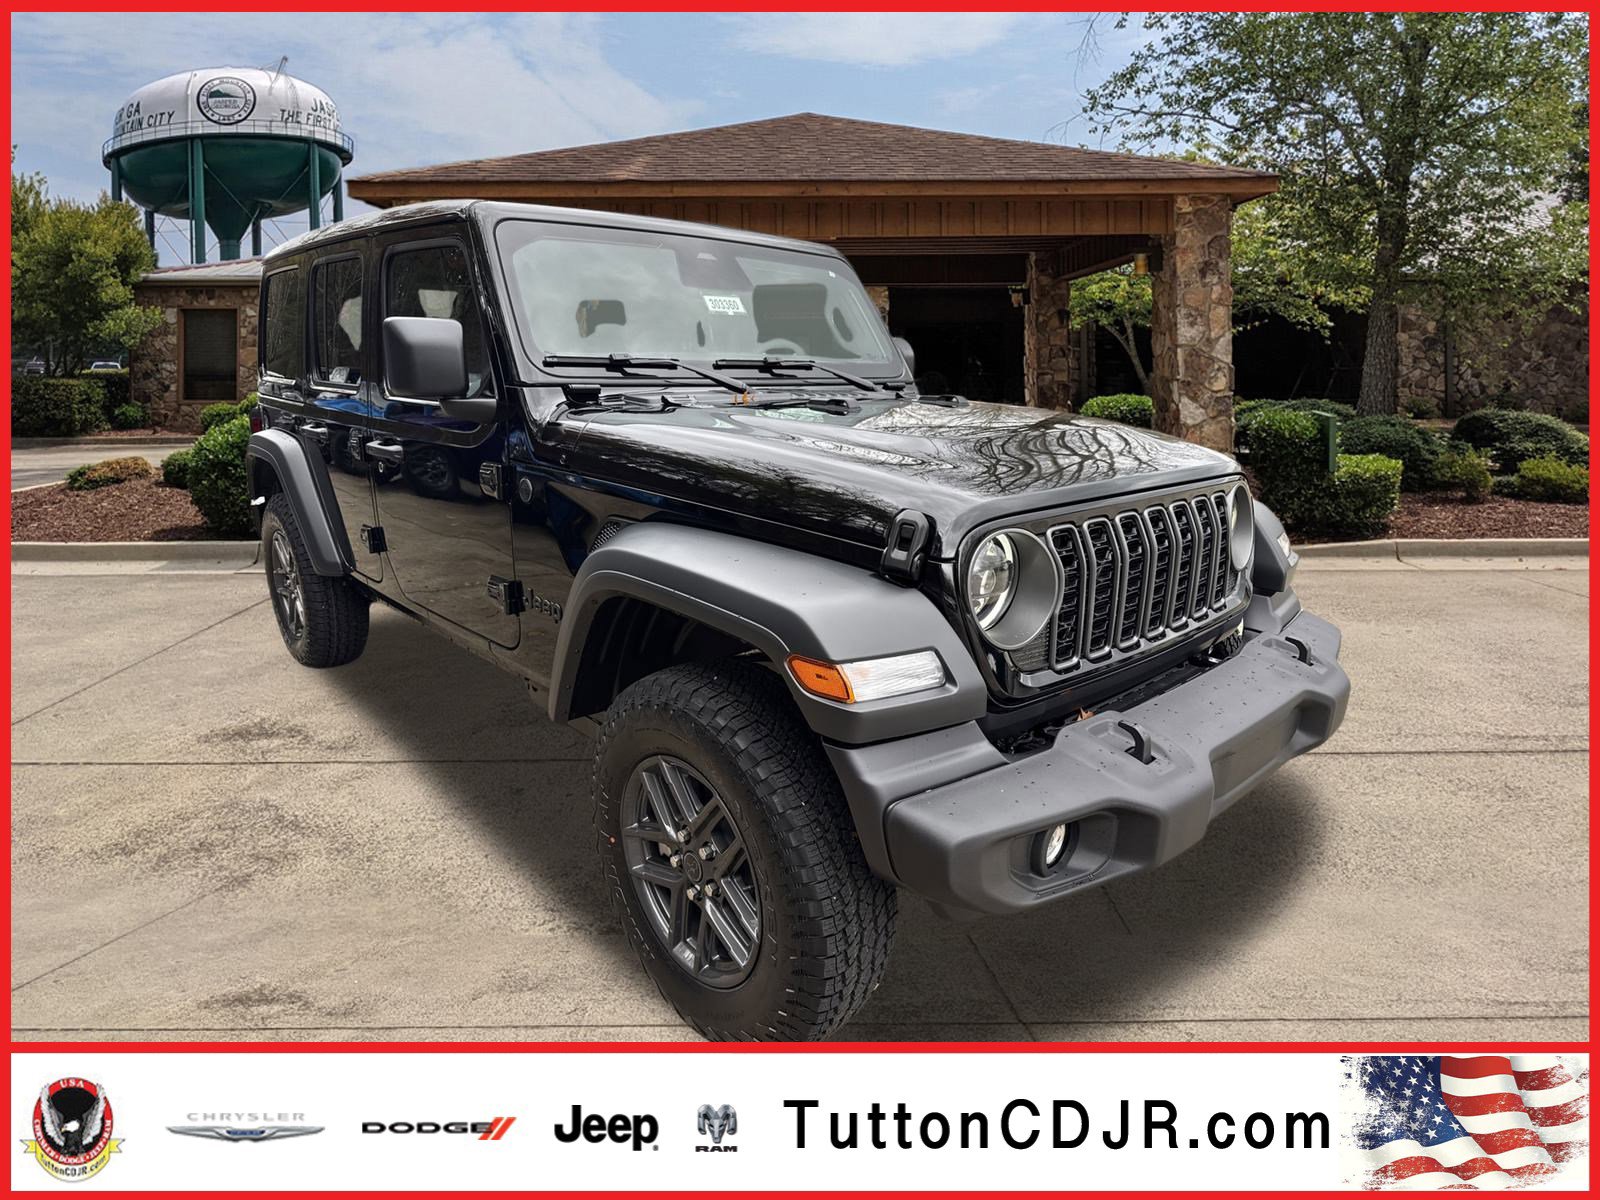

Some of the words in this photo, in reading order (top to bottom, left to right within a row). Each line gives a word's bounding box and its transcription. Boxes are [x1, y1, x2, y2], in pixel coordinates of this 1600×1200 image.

[126, 101, 141, 119] GA
[147, 111, 175, 127] CITY
[280, 109, 302, 124] THE
[306, 112, 332, 129] FIRST
[708, 298, 740, 310] 303360
